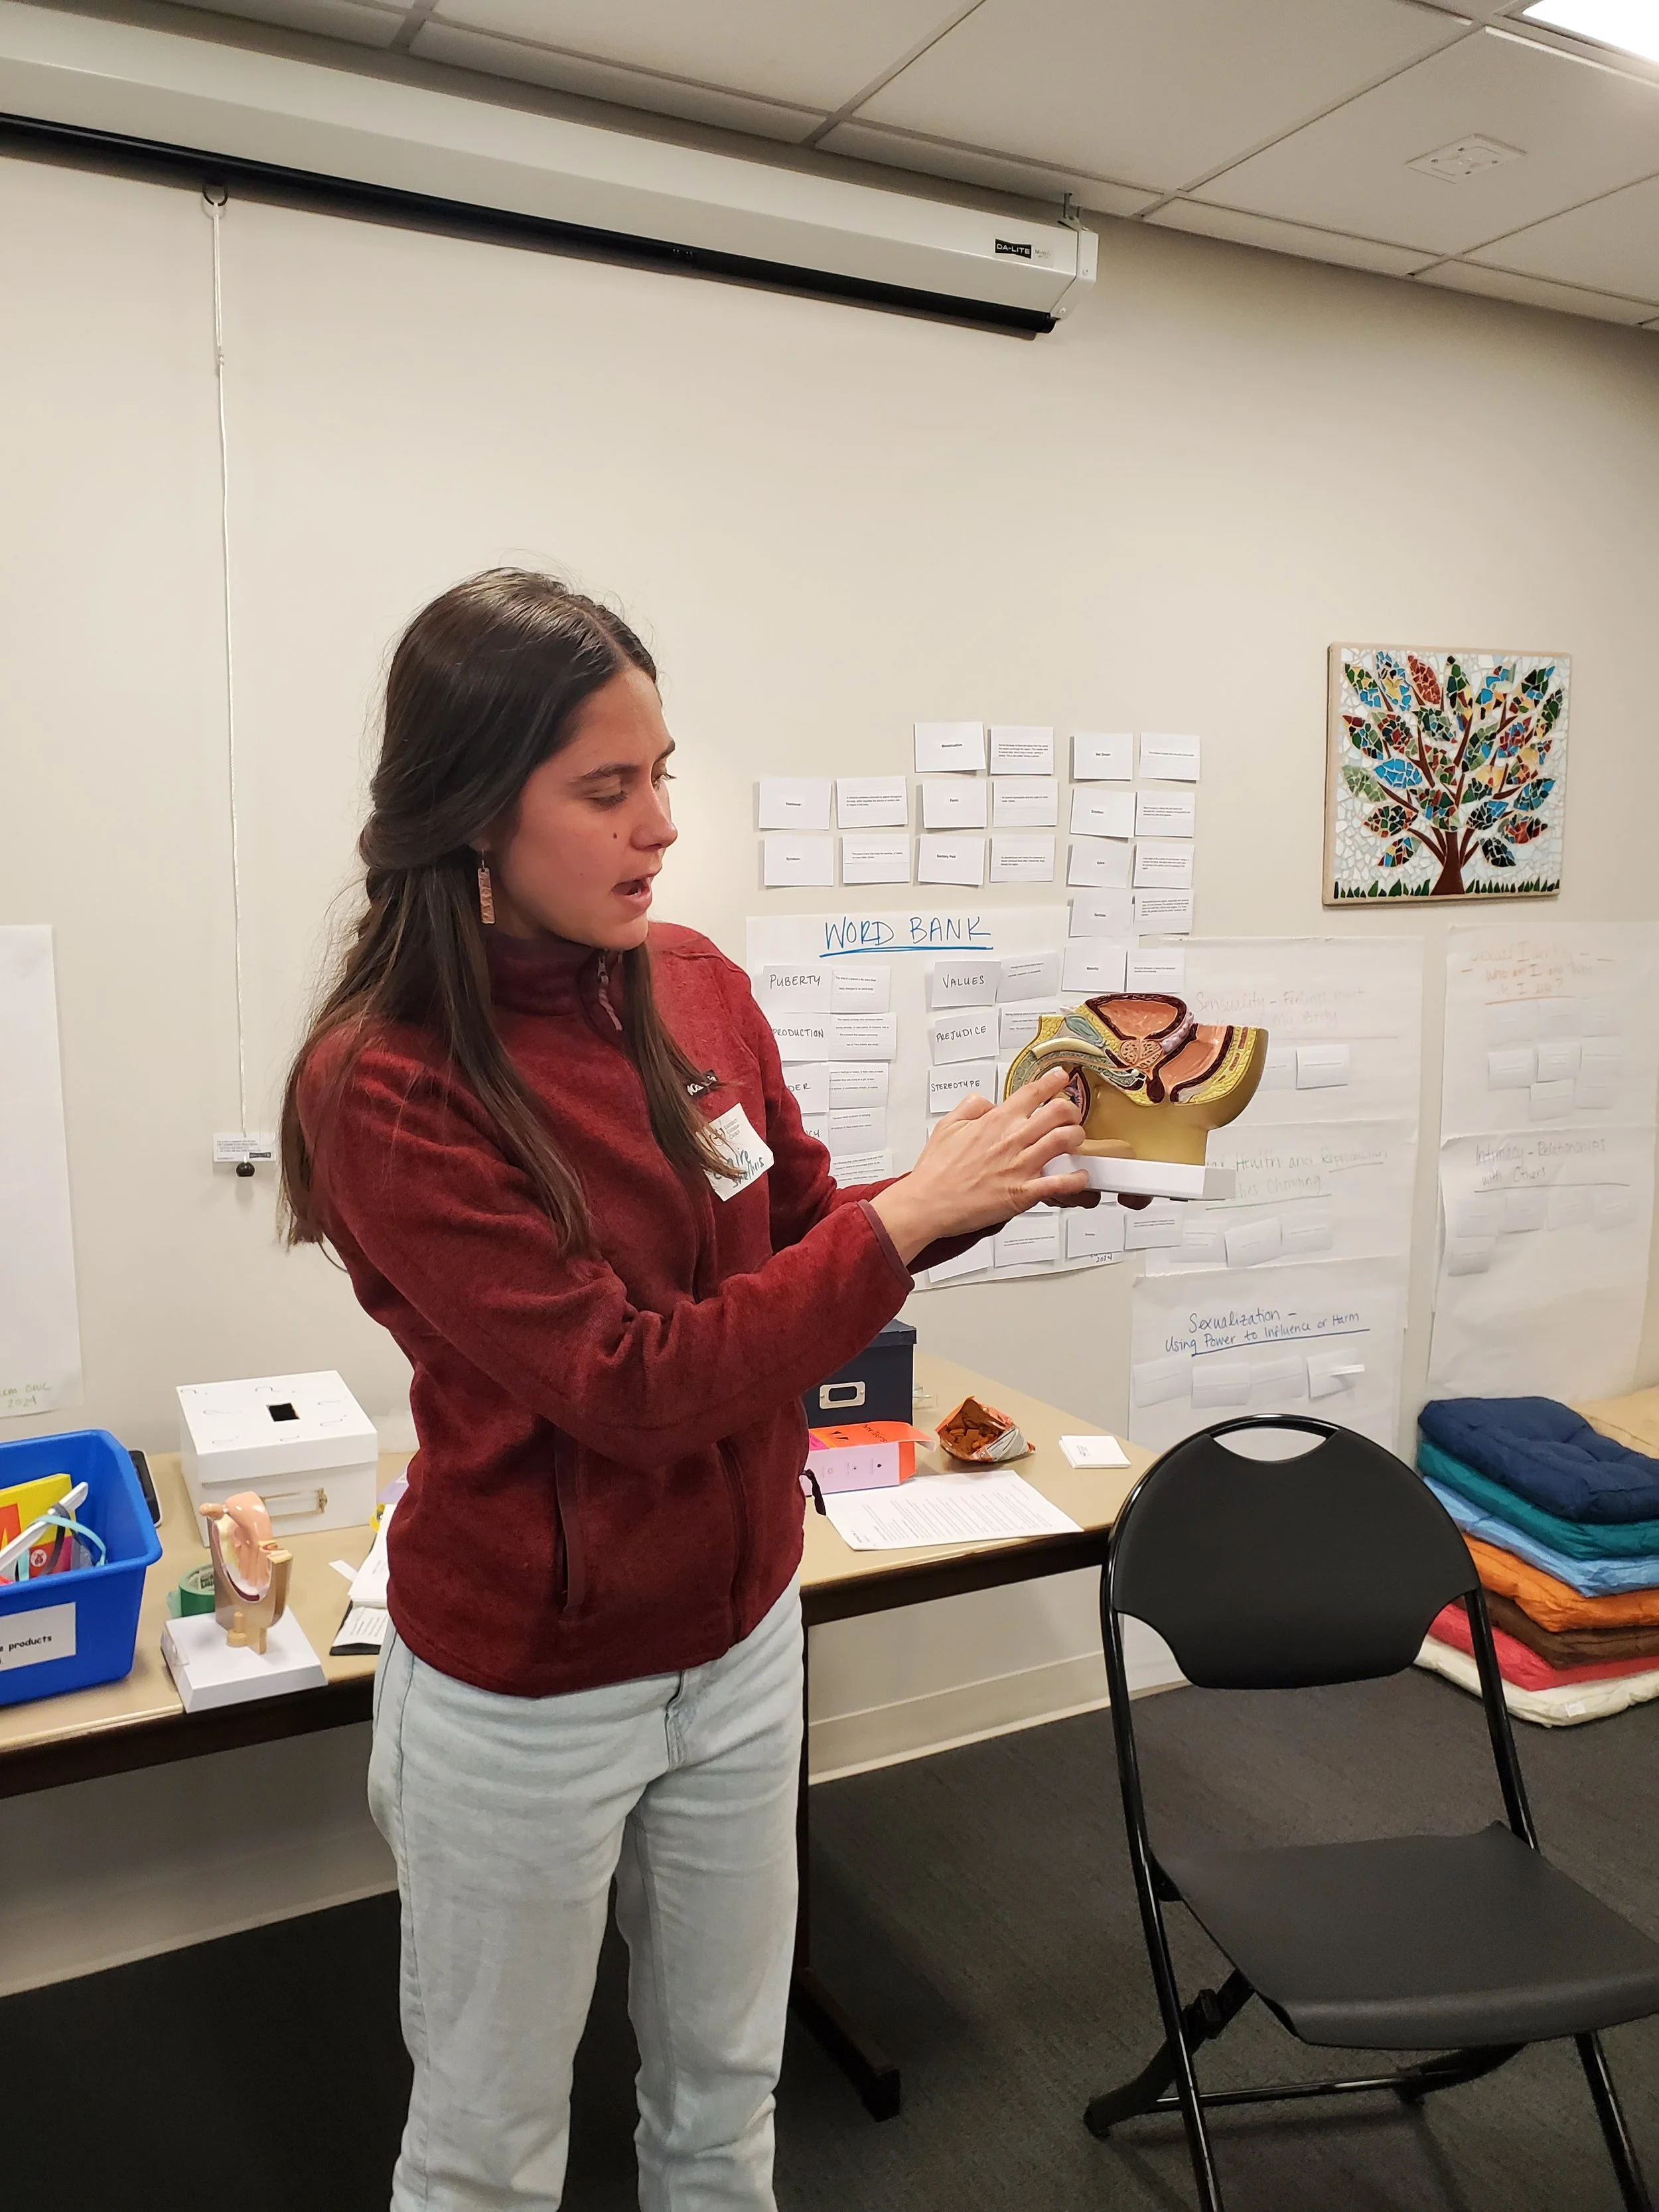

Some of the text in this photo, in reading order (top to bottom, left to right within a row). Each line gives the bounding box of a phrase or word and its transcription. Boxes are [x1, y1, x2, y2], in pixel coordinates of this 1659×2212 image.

[997, 244, 1030, 254] DA-LITE
[826, 916, 991, 950] WORD BANK
[770, 974, 820, 990] PUBERTY
[942, 974, 985, 989] VALUES
[772, 1028, 824, 1038] PRODUCTION
[936, 1025, 987, 1043] PREJUDICE
[788, 1082, 811, 1092] DER
[931, 1080, 980, 1092] STEREOTYPE
[1236, 1150, 1281, 1173] Health
[1513, 1165, 1546, 1182] Others
[1189, 1307, 1280, 1333] Sexualization
[1165, 1312, 1359, 1355] Using Power to Influence or Harm
[9, 1635, 52, 1652] products
